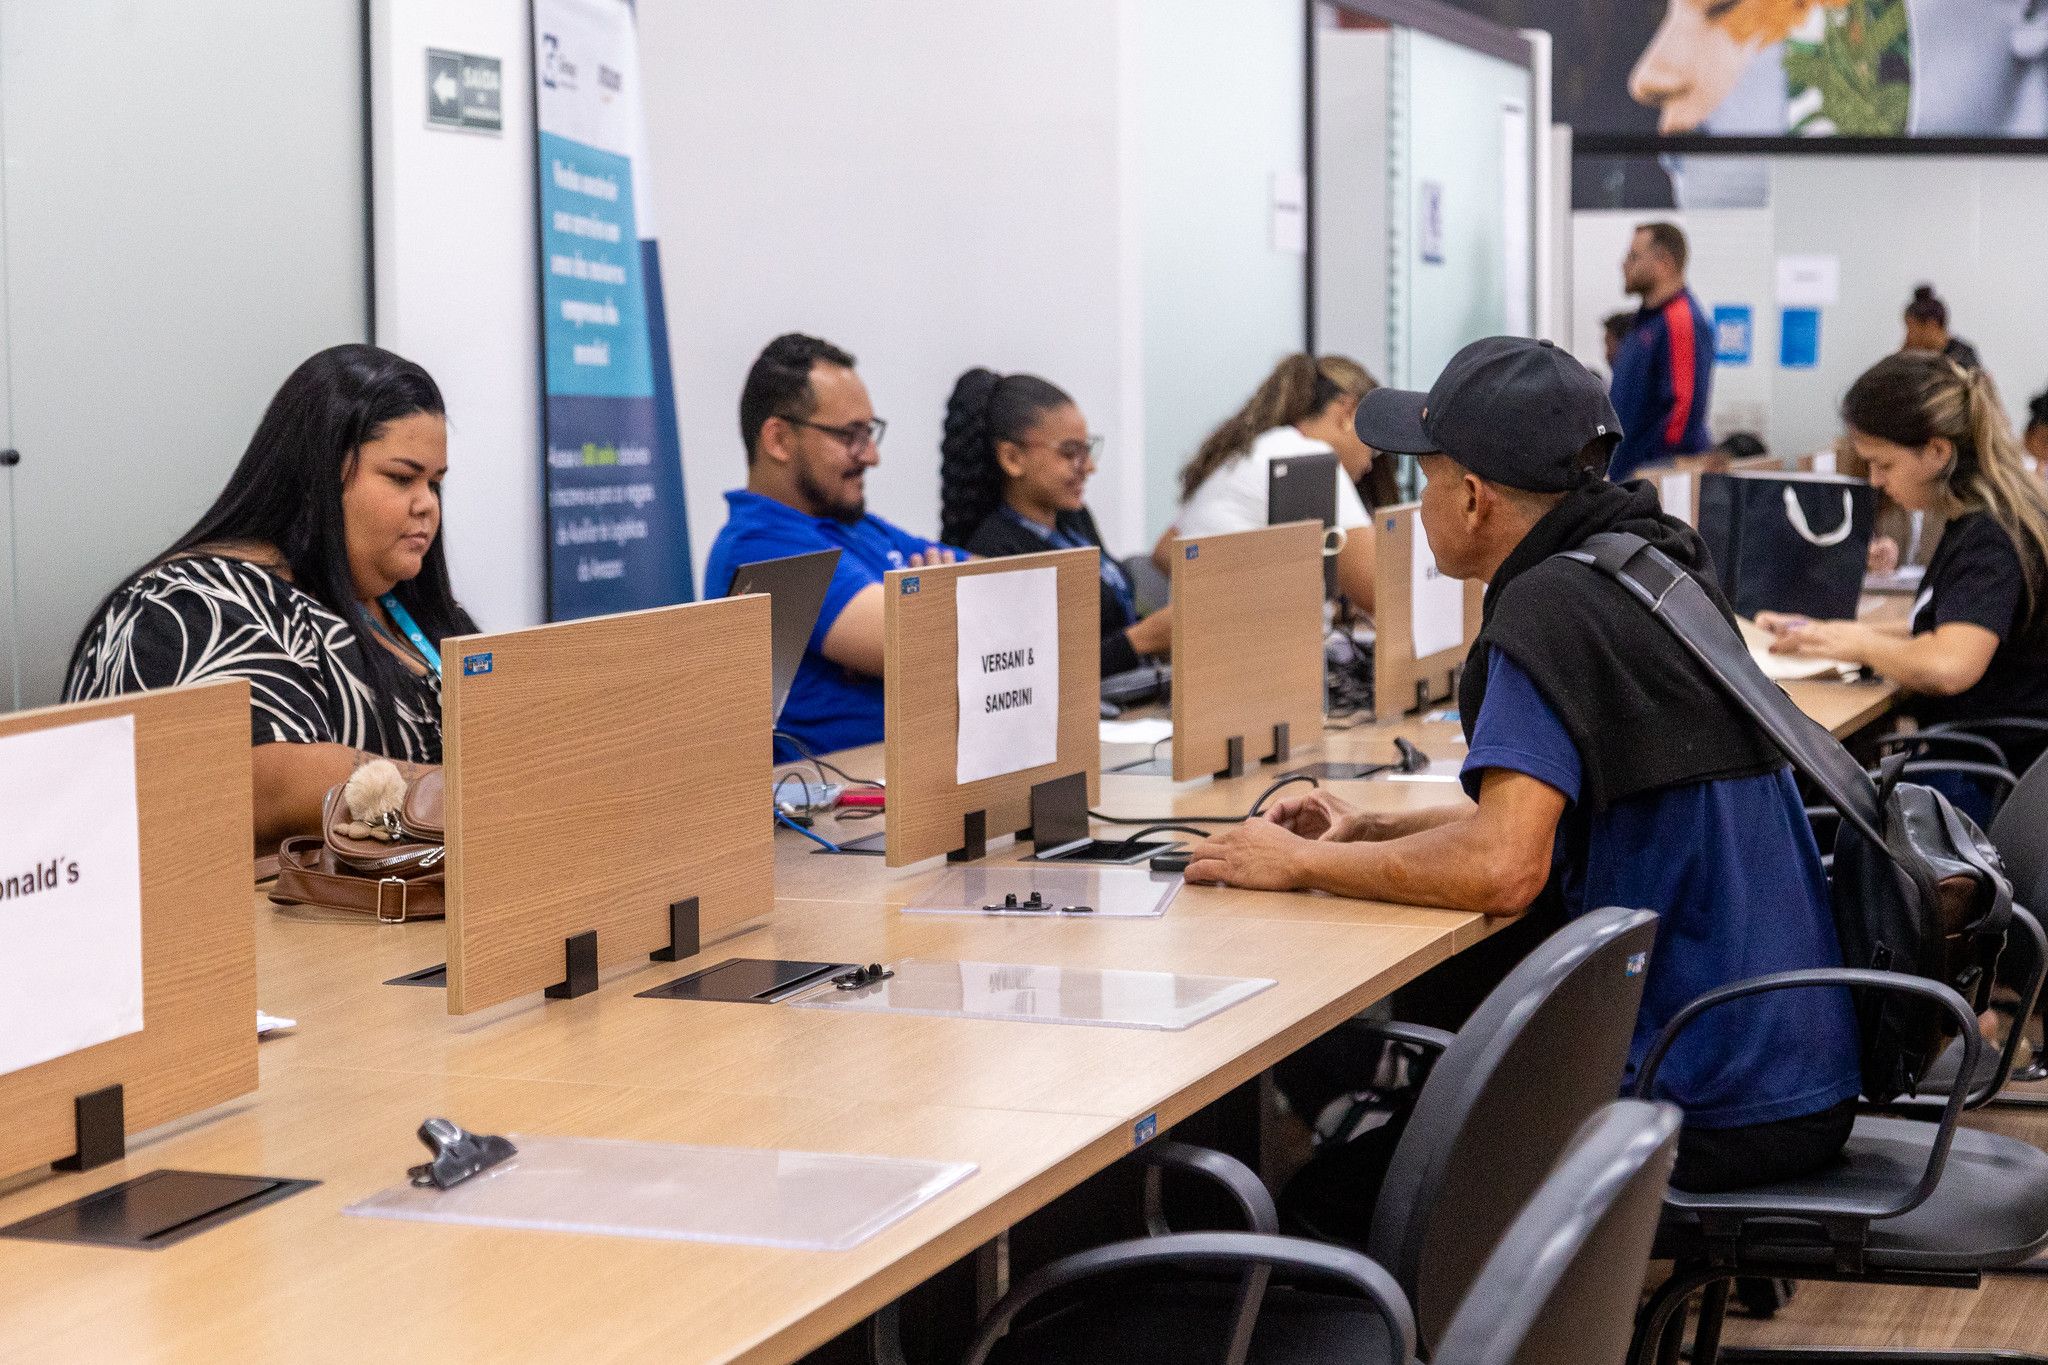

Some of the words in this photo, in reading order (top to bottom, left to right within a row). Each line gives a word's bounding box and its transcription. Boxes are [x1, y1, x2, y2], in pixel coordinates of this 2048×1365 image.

[981, 649, 1025, 674] VERSANI
[1027, 647, 1034, 666] &
[985, 687, 1032, 714] SANDRINI
